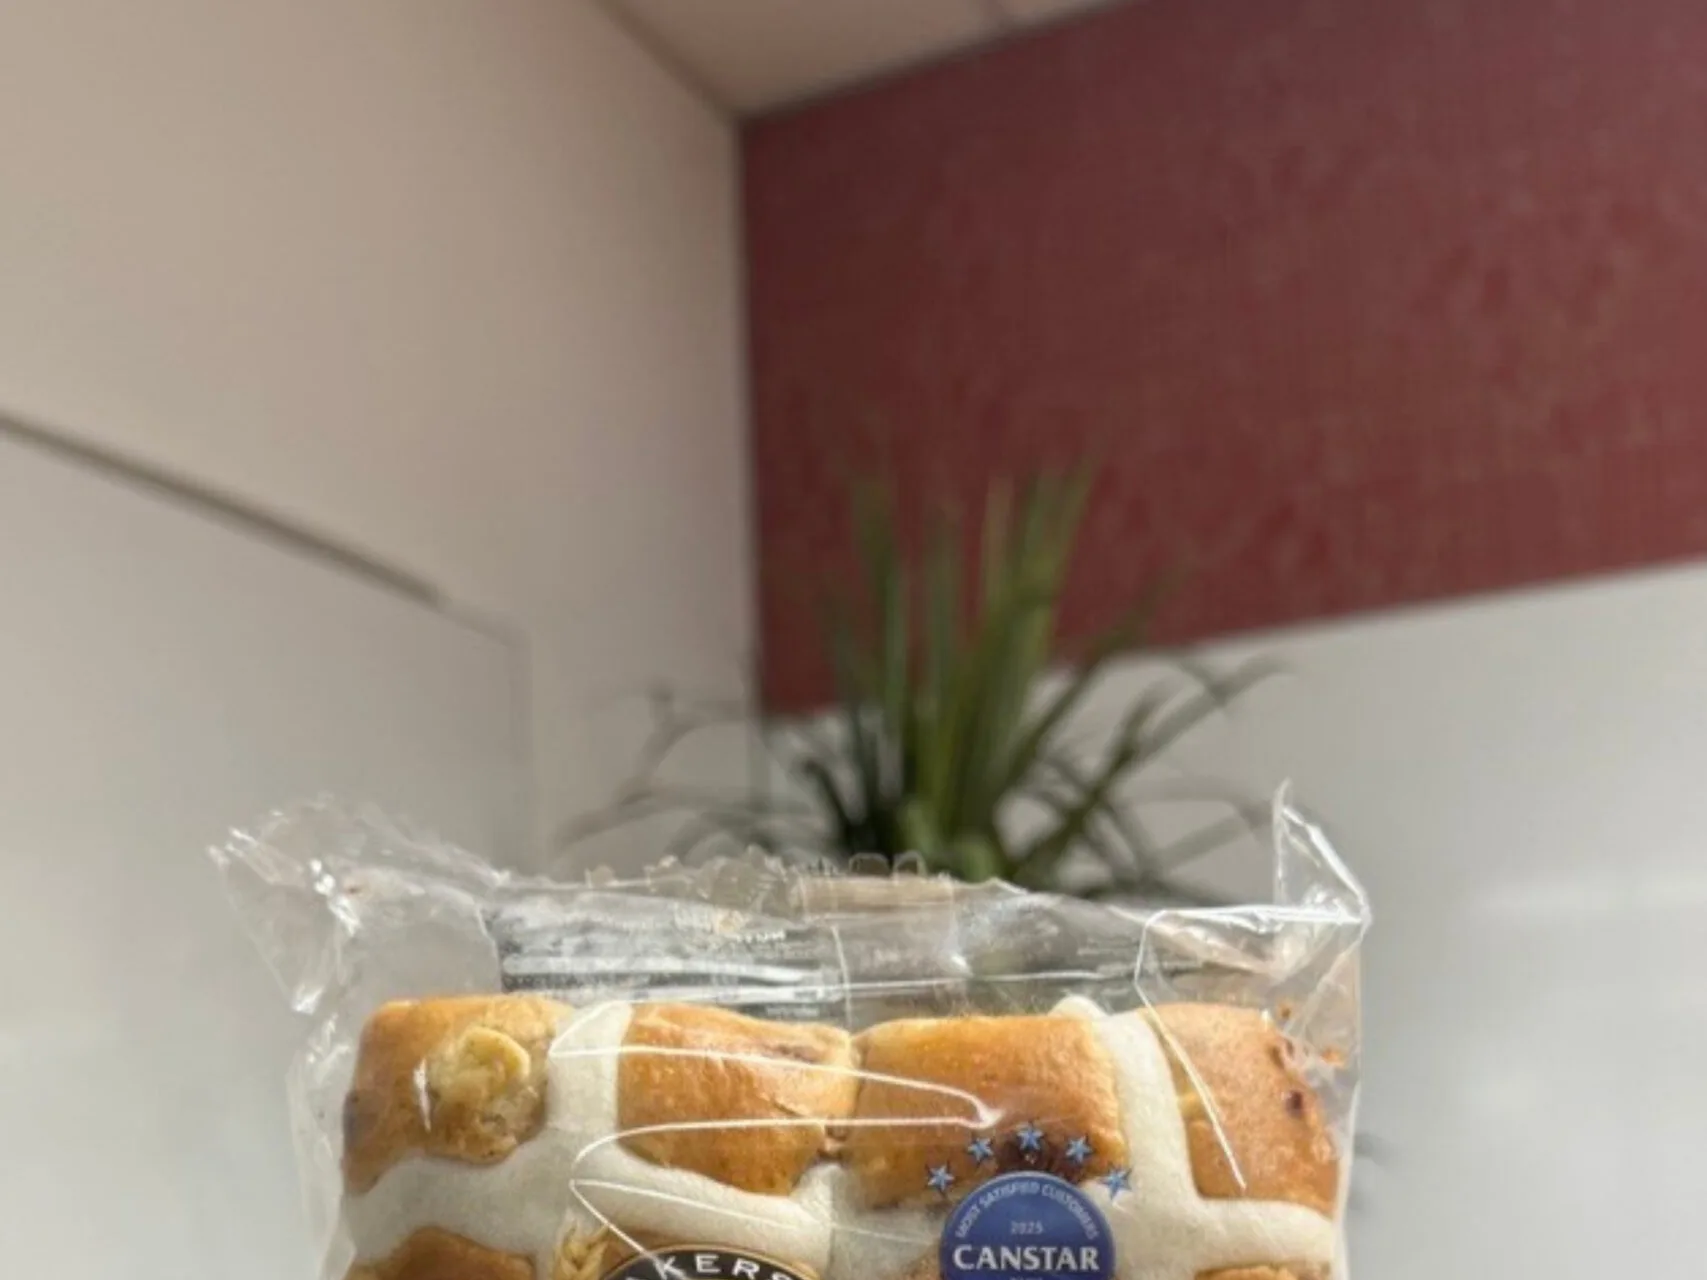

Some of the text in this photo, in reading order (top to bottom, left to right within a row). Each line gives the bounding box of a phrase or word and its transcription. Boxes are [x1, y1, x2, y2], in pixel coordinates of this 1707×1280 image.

[955, 1181, 1099, 1239] MOST SATISFIED CUSTOMERS
[1011, 1222, 1043, 1235] 2025
[953, 1244, 1099, 1270] CANSTAR
